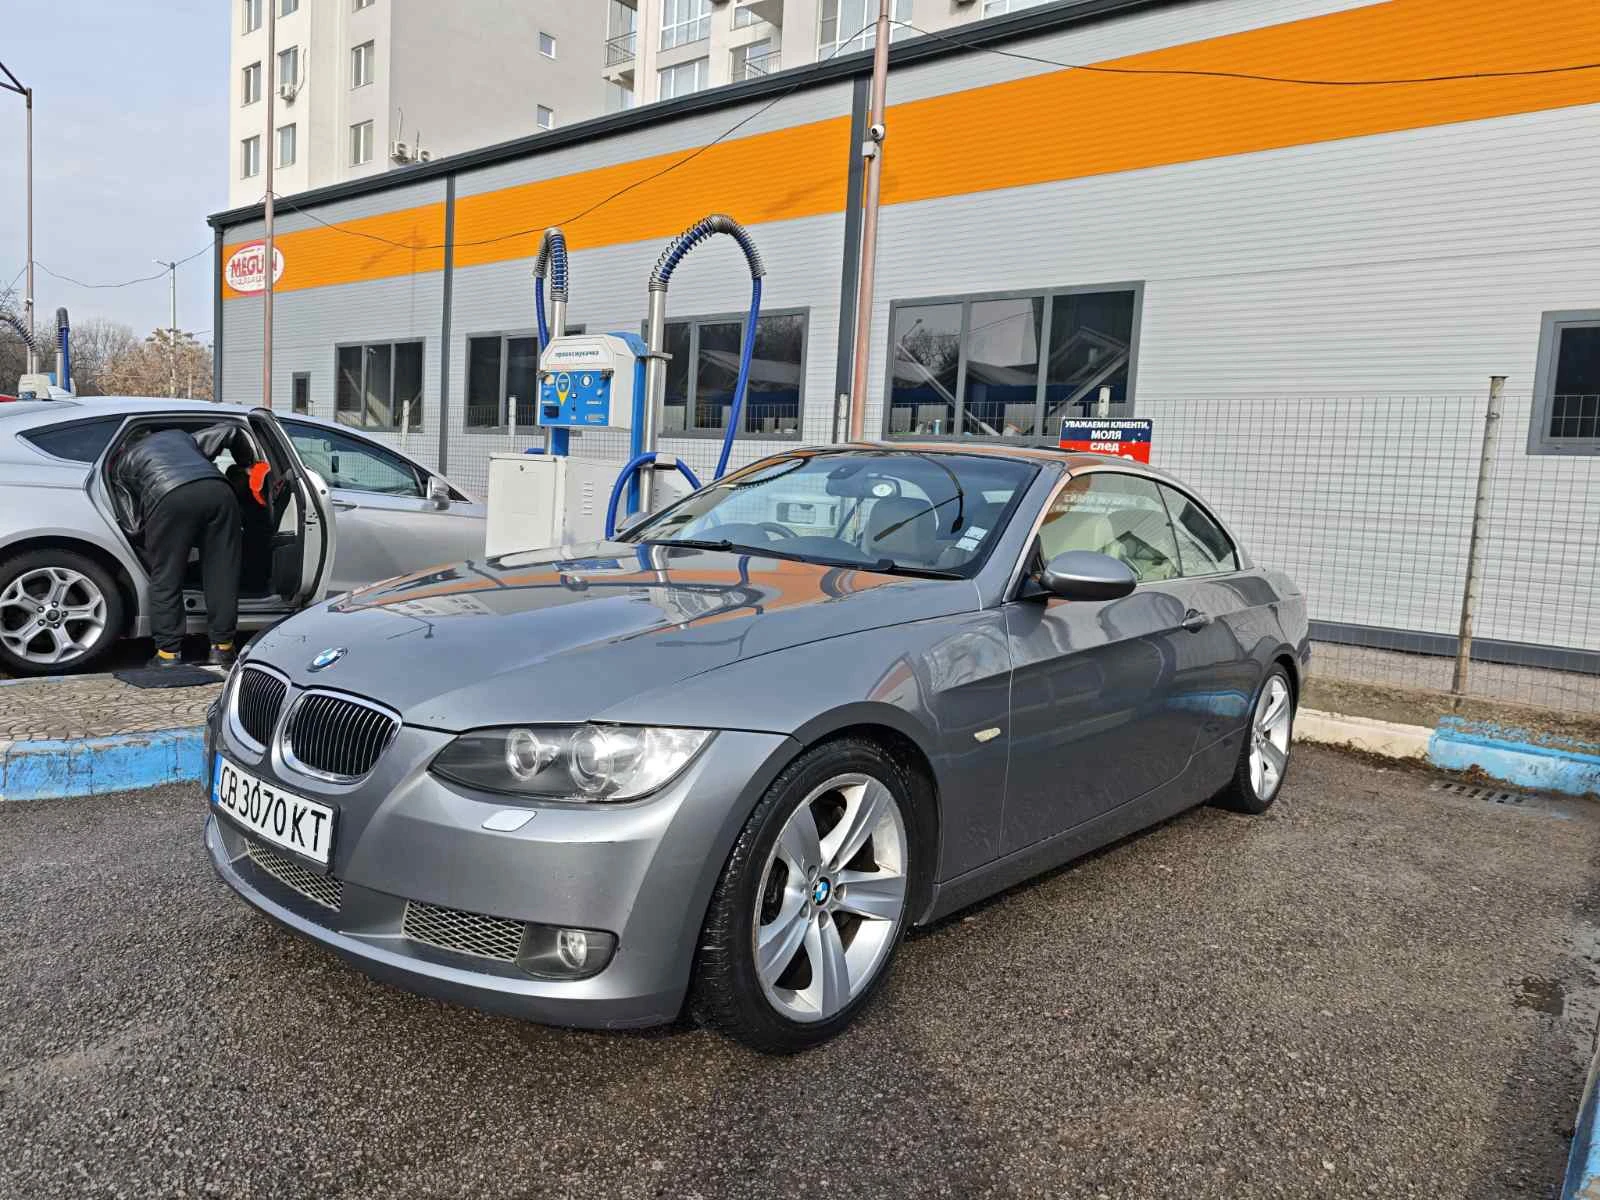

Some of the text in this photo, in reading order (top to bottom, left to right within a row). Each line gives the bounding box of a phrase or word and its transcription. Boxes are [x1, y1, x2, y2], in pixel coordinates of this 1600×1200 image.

[230, 254, 278, 278] MEGUN
[1065, 421, 1150, 430] УВАЖАЕМИ КЛИЕНТИ,
[1090, 430, 1122, 440] МОЛЯ
[1090, 442, 1120, 453] след
[220, 766, 327, 852] CB 3070 KT
